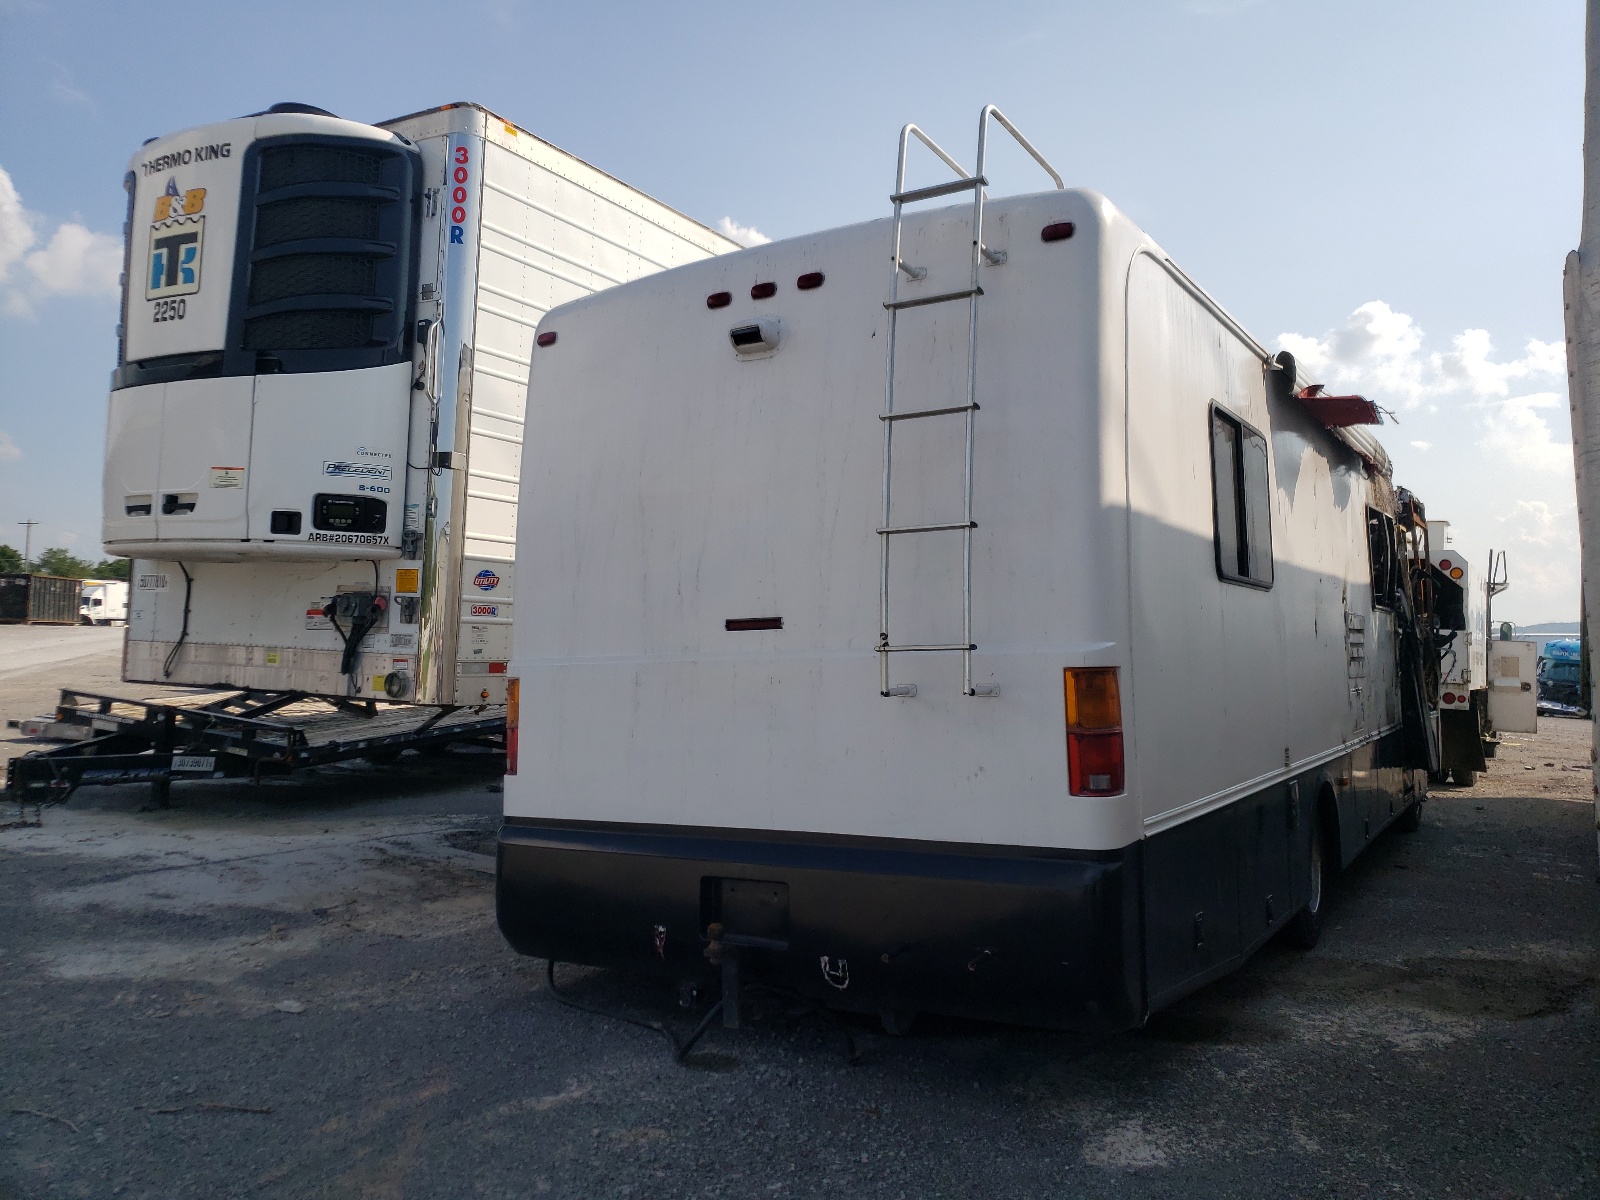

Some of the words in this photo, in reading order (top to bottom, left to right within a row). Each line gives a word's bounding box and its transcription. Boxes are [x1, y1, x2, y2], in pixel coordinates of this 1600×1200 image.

[141, 149, 192, 176] THERMO
[194, 142, 231, 162] KING
[450, 146, 469, 244] 3000R
[152, 298, 186, 323] 2250
[326, 463, 390, 475] PRECEDENT
[308, 532, 390, 545] ARB#20670657X
[474, 576, 499, 586] UTILITY
[472, 605, 496, 616] 3000R
